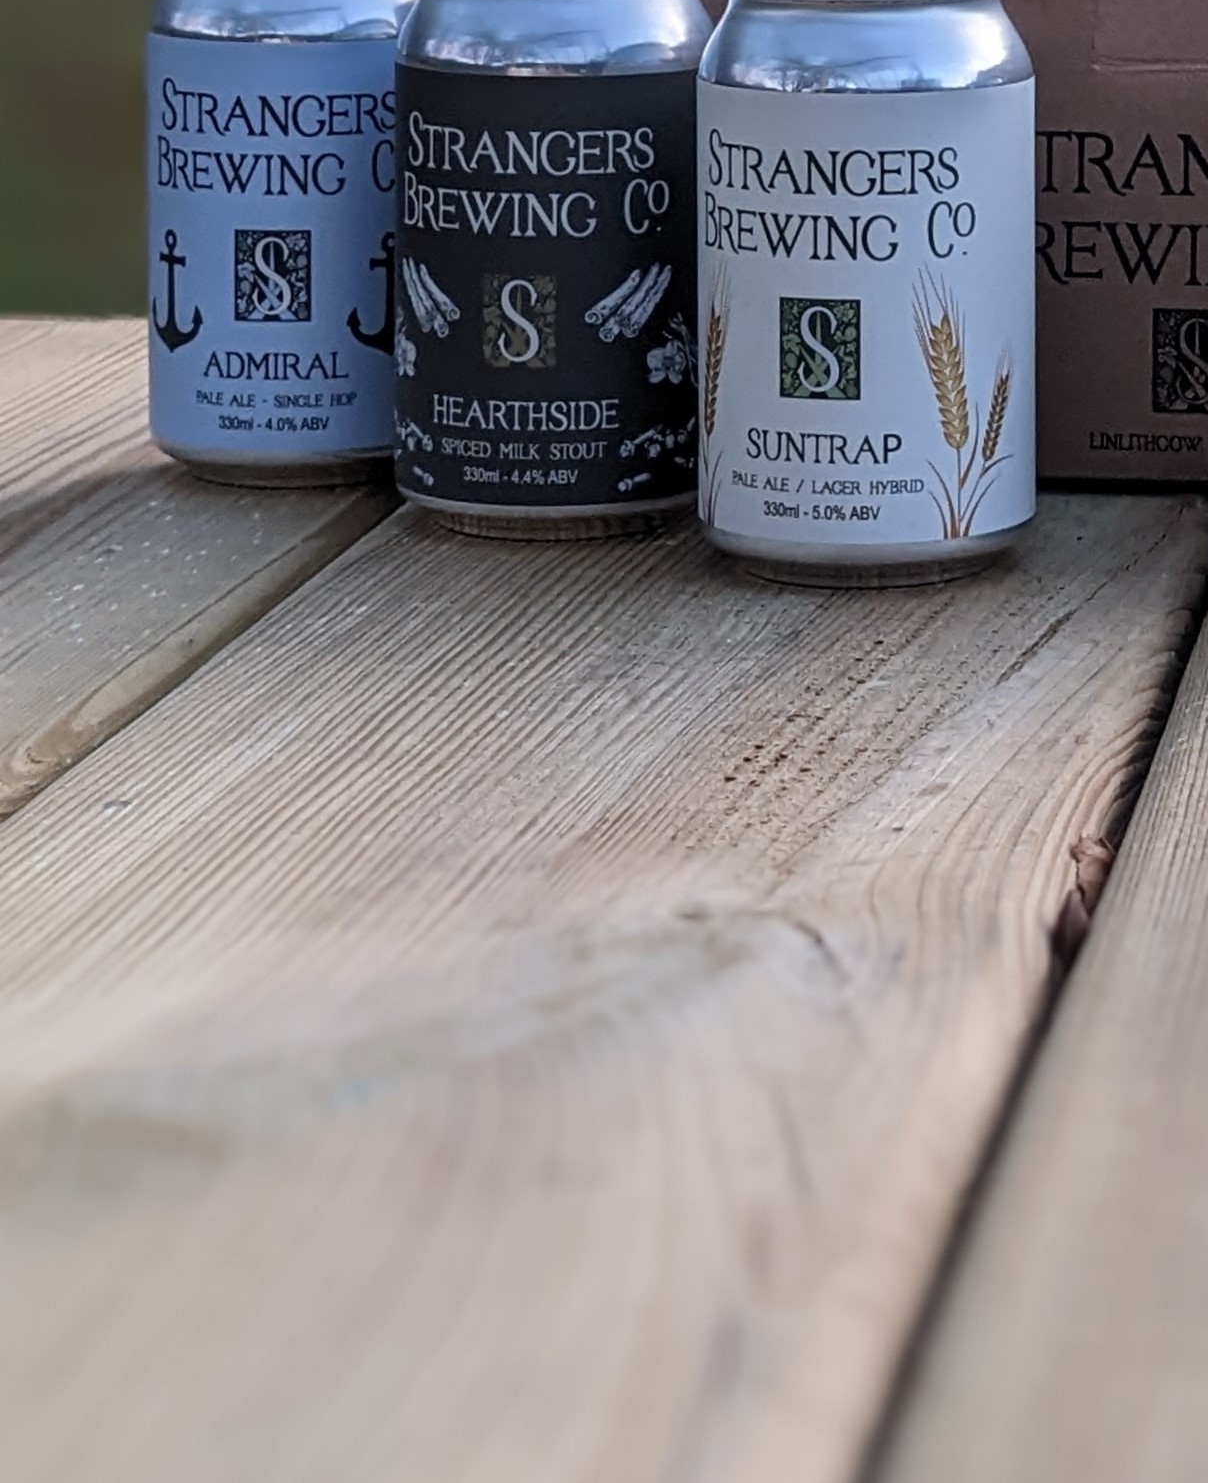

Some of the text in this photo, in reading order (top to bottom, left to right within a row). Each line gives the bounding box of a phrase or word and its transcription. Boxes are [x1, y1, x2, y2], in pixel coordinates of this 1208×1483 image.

[162, 77, 395, 137] STRANGERS
[408, 111, 655, 175] STRANGERS
[157, 135, 346, 196] BREWING
[709, 128, 959, 197] STRANGERS
[403, 171, 597, 237] BREWING
[705, 190, 898, 261] BREWING
[204, 351, 349, 380] ADMIRAL
[196, 390, 224, 406] PALE
[229, 393, 255, 407] ALE
[273, 393, 322, 408] SINGLE
[330, 392, 357, 406] HOP
[432, 394, 620, 431] HEARTHSIDE
[218, 416, 254, 431] 330ml
[265, 416, 297, 431] 4.0%
[300, 416, 329, 431] ABV
[441, 437, 607, 460] SPICED MILK STOUT
[746, 427, 903, 465] SUNTRAP
[1089, 432, 1202, 453] LINLITHGOW
[463, 466, 500, 483] 330ml
[511, 470, 545, 484] 4.4%
[549, 469, 578, 484] ABV
[732, 470, 758, 489] PALE
[763, 475, 789, 492] ALE
[811, 479, 860, 495] LAGER
[869, 478, 924, 495] HYBRID
[763, 500, 800, 518] 330ml
[812, 504, 846, 520] 5.0%
[850, 505, 881, 520] ABV
